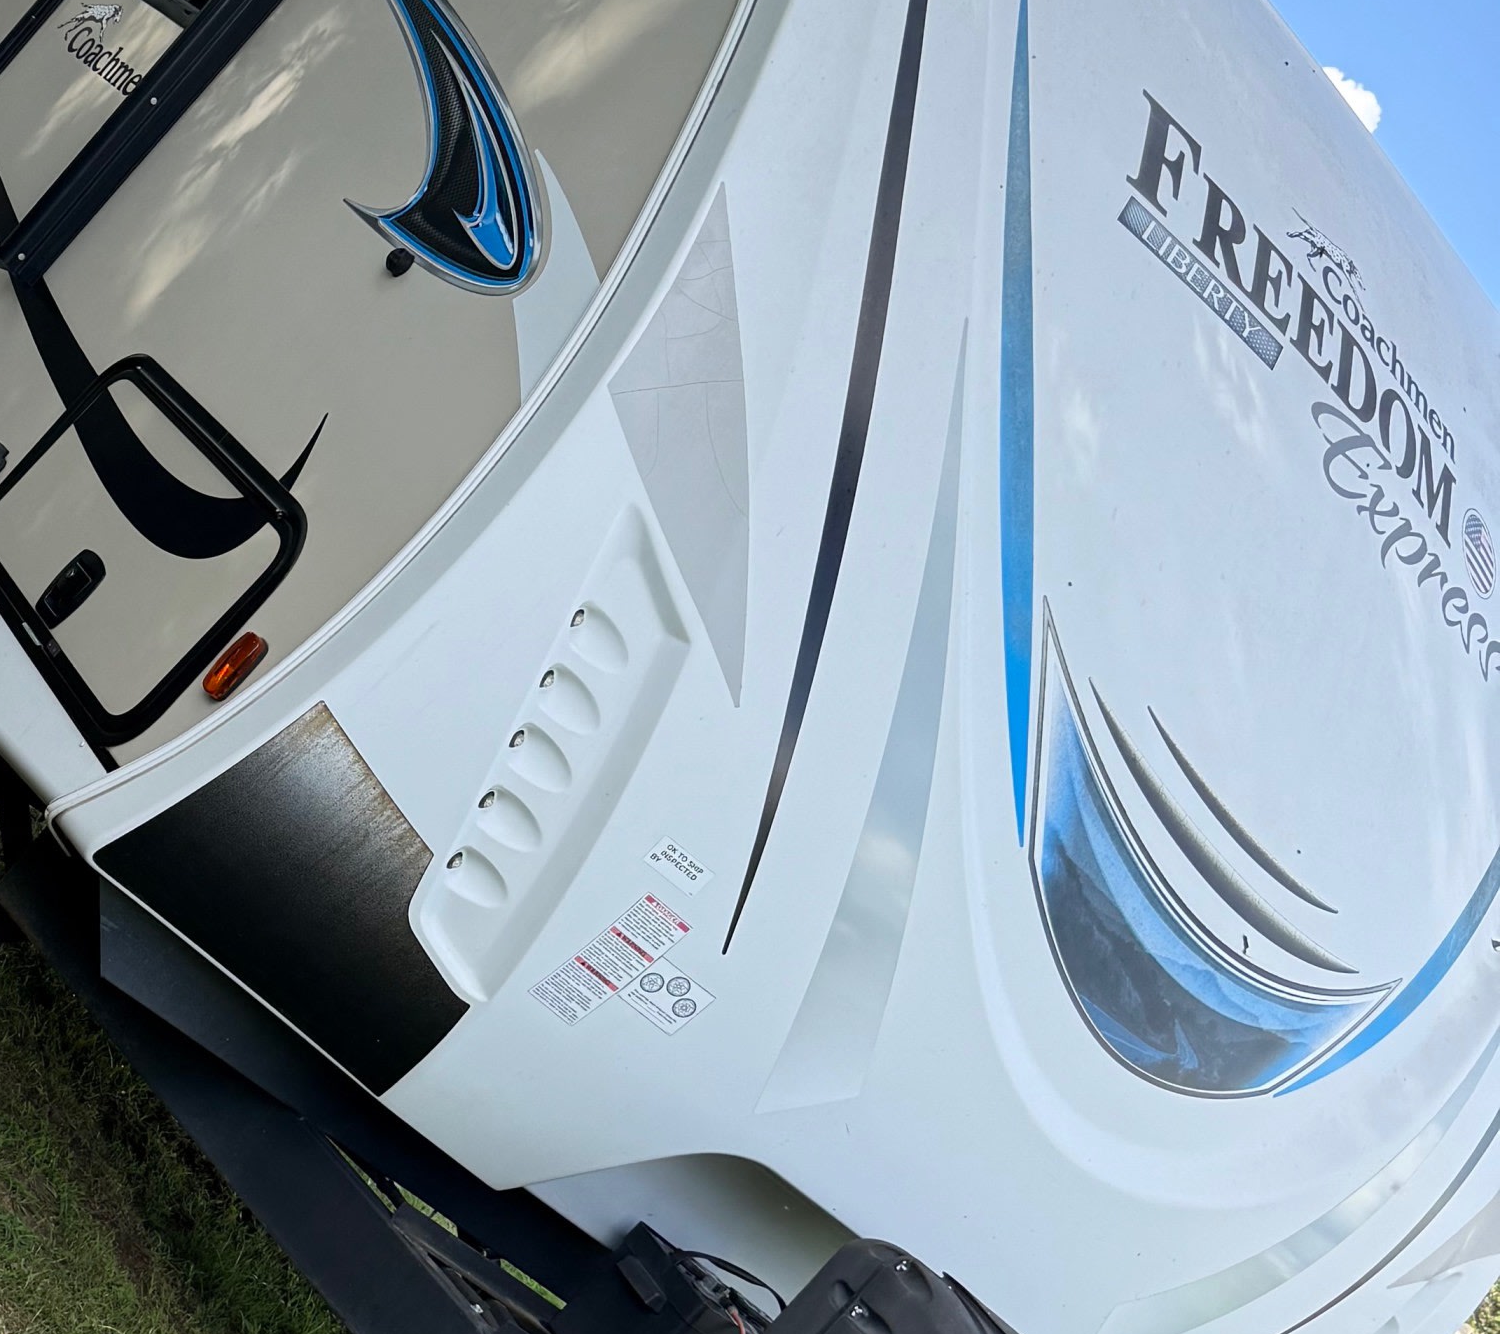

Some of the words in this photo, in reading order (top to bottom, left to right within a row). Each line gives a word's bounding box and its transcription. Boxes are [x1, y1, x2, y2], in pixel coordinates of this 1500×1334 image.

[67, 26, 143, 96] Coachme
[1125, 88, 1457, 549] FREEDOM
[1141, 219, 1262, 338] LIBERTY
[1322, 265, 1456, 464] Coachmen
